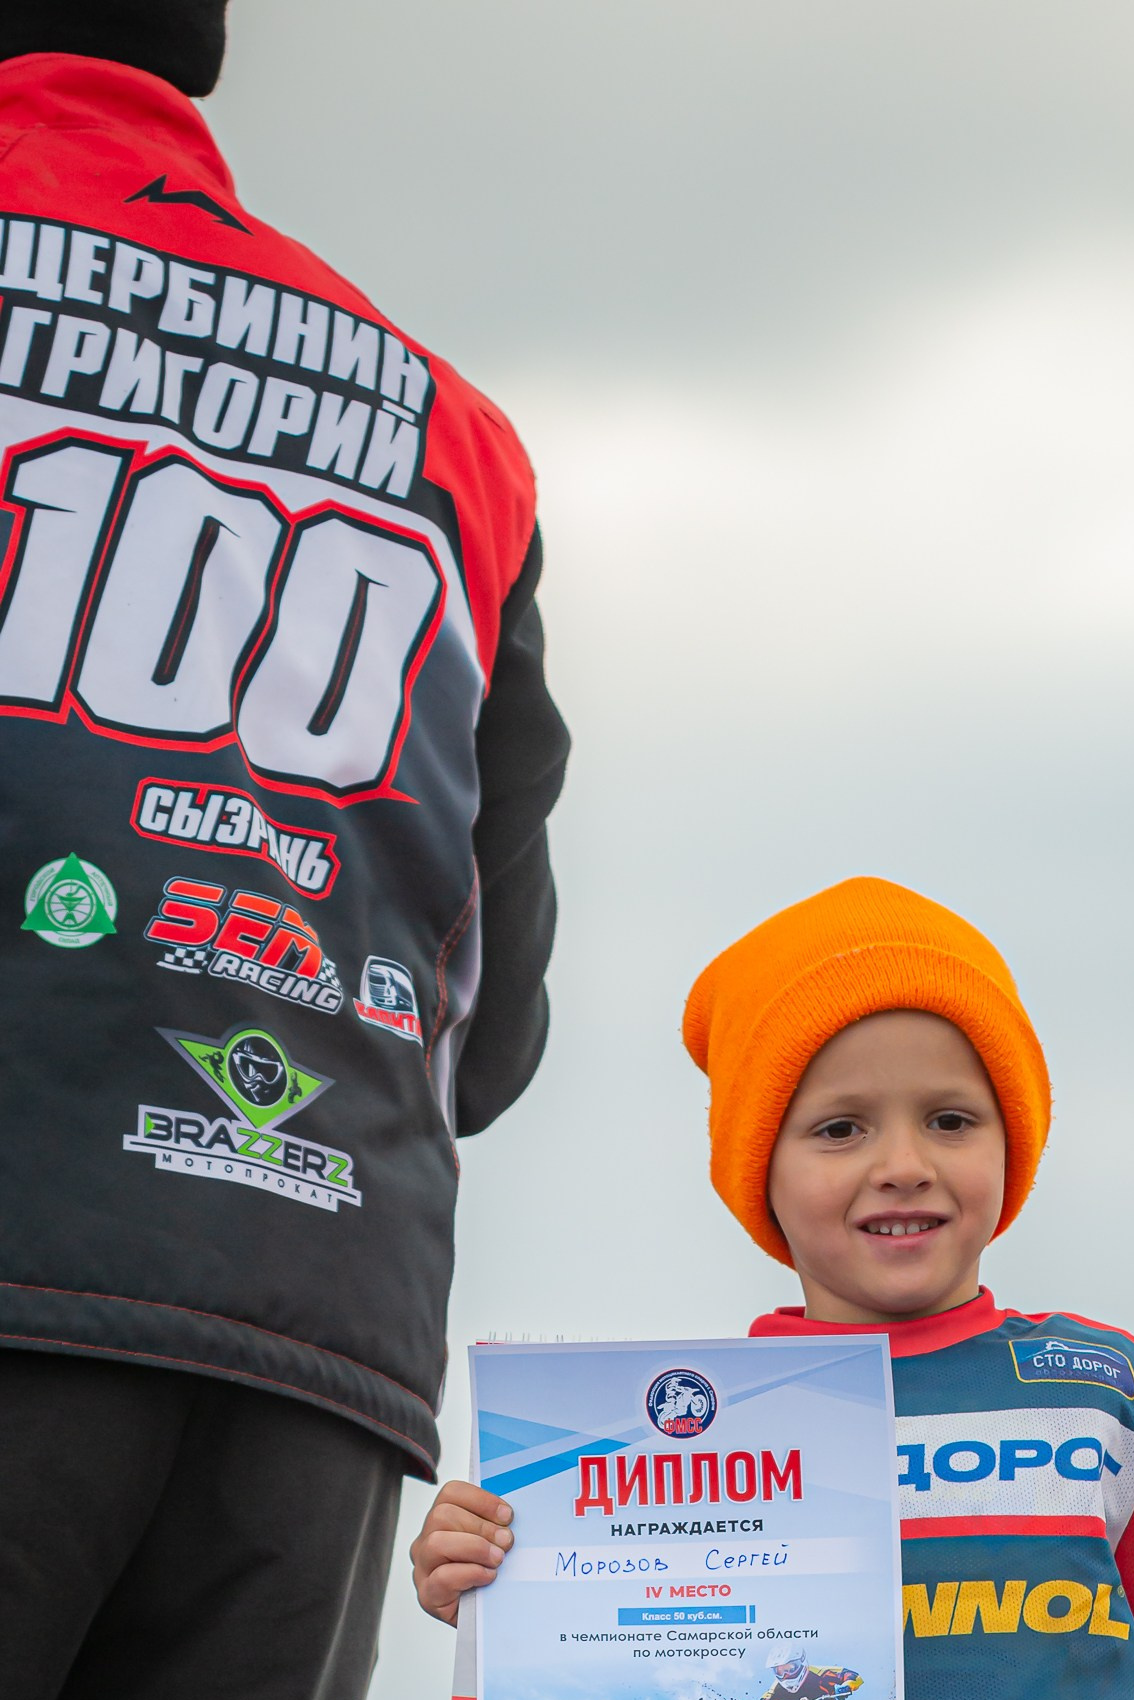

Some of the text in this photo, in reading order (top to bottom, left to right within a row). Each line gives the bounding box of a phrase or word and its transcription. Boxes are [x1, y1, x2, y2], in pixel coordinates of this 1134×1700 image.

[0, 305, 420, 499] ГРИГОРИЙ
[0, 443, 443, 790] 100
[139, 786, 331, 890] СЫЗРАНЬ
[212, 953, 342, 1010] RACING
[143, 1111, 349, 1188] BRAZZERZ
[161, 1152, 334, 1204] МОТОПРОКАТ
[1033, 1354, 1066, 1368] СТО
[1072, 1356, 1121, 1379] ДОРОГ
[664, 1418, 703, 1434] ФМСС
[575, 1450, 804, 1517] ДИПЛОМ
[611, 1519, 764, 1537] НАГРАЖДАЕТСЯ
[645, 1586, 663, 1599] IV
[669, 1584, 732, 1598] МЕСТО
[642, 1612, 671, 1622] Класс
[674, 1611, 685, 1621] 50
[560, 1627, 819, 1644] в чемпионате Самарской области
[633, 1646, 746, 1661] по мотокроссу
